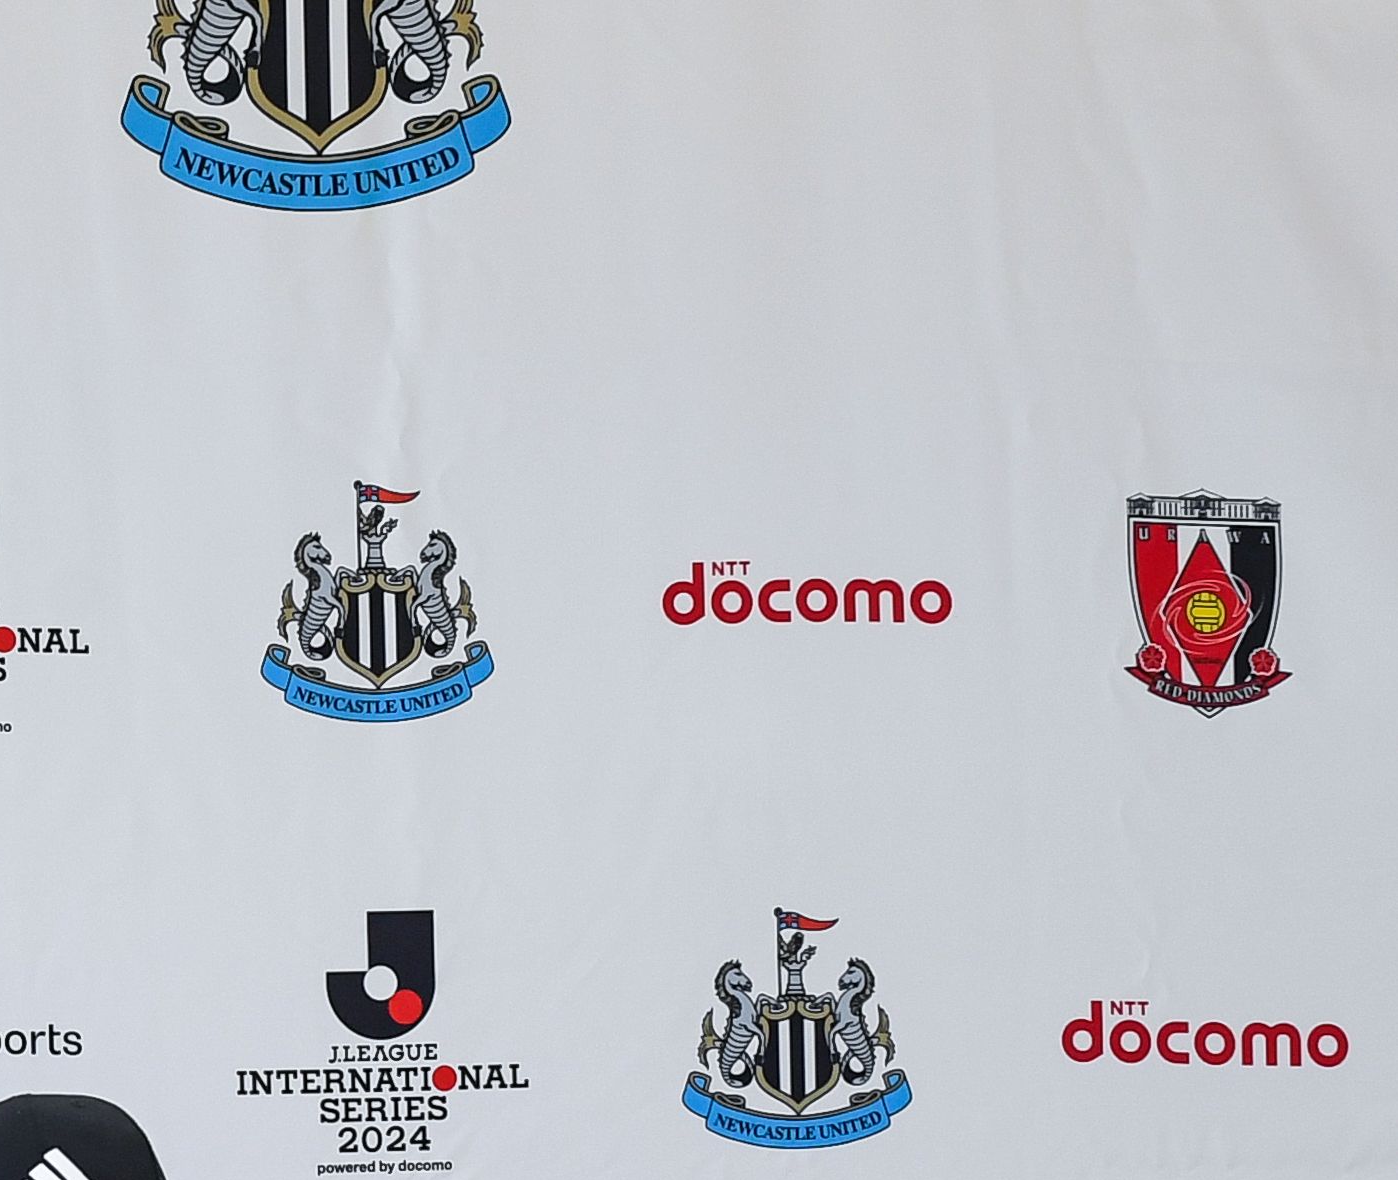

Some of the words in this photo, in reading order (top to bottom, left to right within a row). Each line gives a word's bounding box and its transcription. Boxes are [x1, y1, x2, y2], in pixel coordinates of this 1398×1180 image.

[173, 146, 350, 198] NEWCASTLE
[355, 145, 461, 194] UNITED
[712, 561, 751, 577] NTT
[662, 562, 953, 626] docomo
[292, 685, 398, 716] NEWCASTLE
[399, 683, 465, 713] UNITED
[1110, 1001, 1150, 1016] NTT
[1061, 1000, 1349, 1068] docomo
[328, 1043, 438, 1064] J.LEAGUE
[236, 1063, 530, 1096] INTERNATIONAL
[319, 1095, 448, 1124] SERIES
[338, 1125, 432, 1154] 2024
[713, 1111, 817, 1141] NEWCASTLE
[819, 1110, 883, 1140] UNITED
[317, 1161, 376, 1176] powered
[379, 1160, 396, 1174] by
[398, 1159, 453, 1172] docomo
